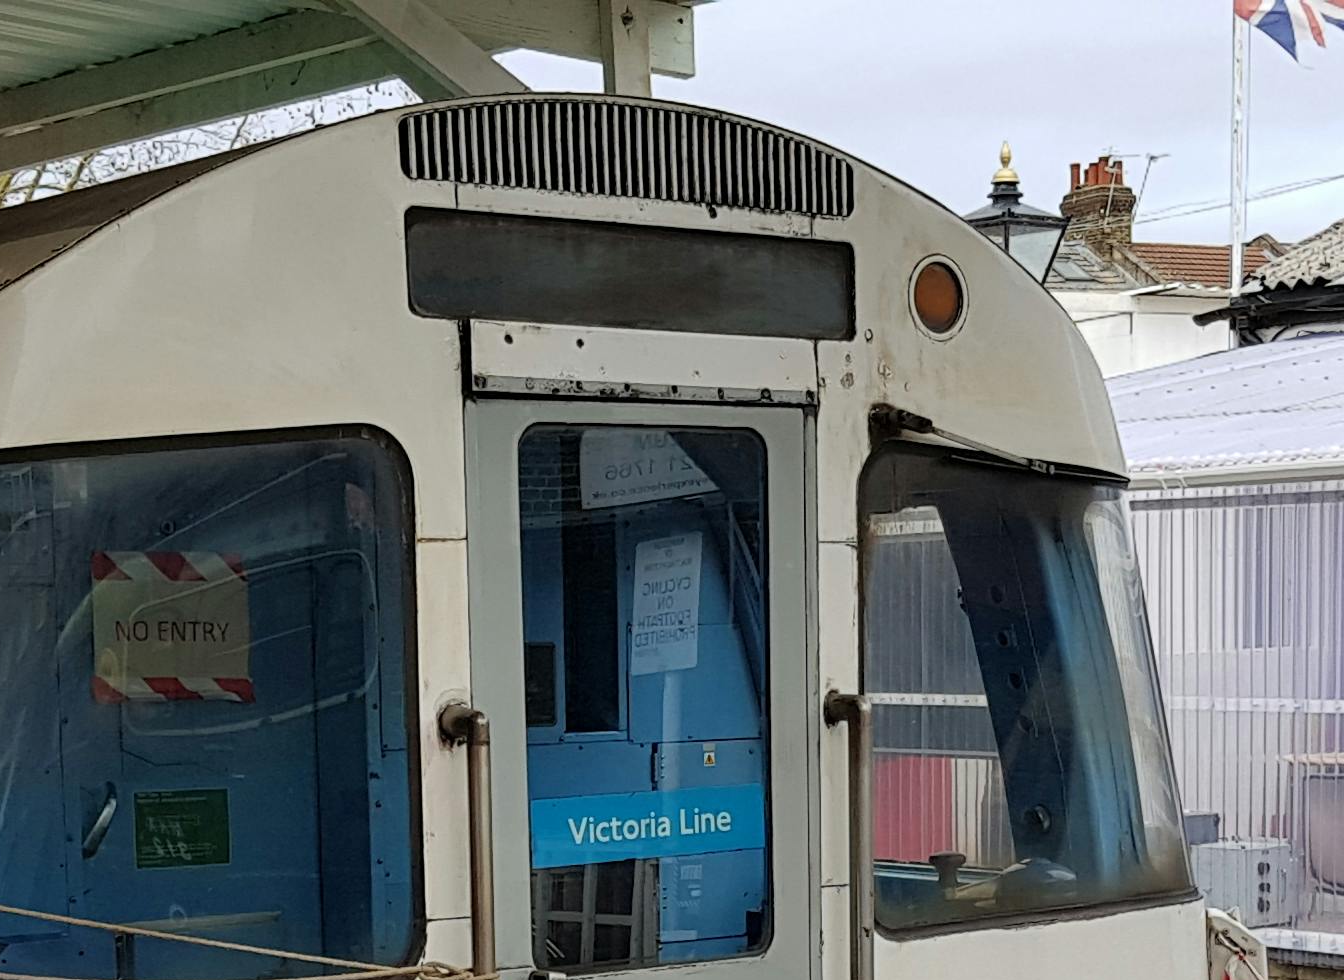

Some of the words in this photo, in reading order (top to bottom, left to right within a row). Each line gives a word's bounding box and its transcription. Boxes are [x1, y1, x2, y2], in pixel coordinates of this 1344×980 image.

[114, 620, 149, 642] NO
[157, 620, 230, 643] ENTRY
[567, 811, 672, 845] Victoria
[678, 807, 733, 836] Line
